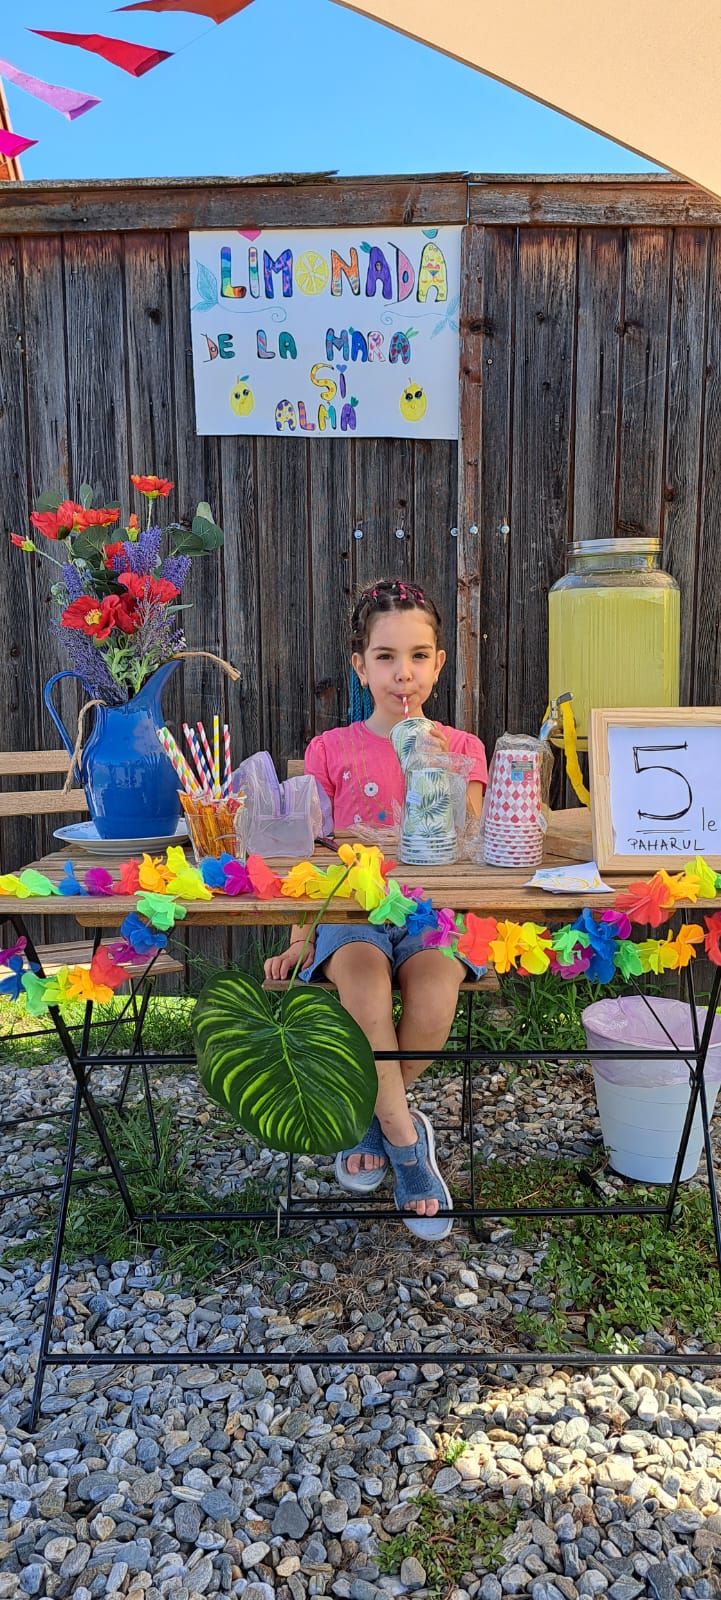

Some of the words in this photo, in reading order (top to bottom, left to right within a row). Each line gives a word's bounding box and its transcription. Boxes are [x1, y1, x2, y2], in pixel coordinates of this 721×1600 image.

[200, 333, 235, 362] DE
[257, 329, 298, 359] LA
[325, 327, 413, 364] MARA
[275, 399, 357, 431] ALMA
[632, 740, 693, 821] 5
[627, 837, 705, 851] PAHARUL
